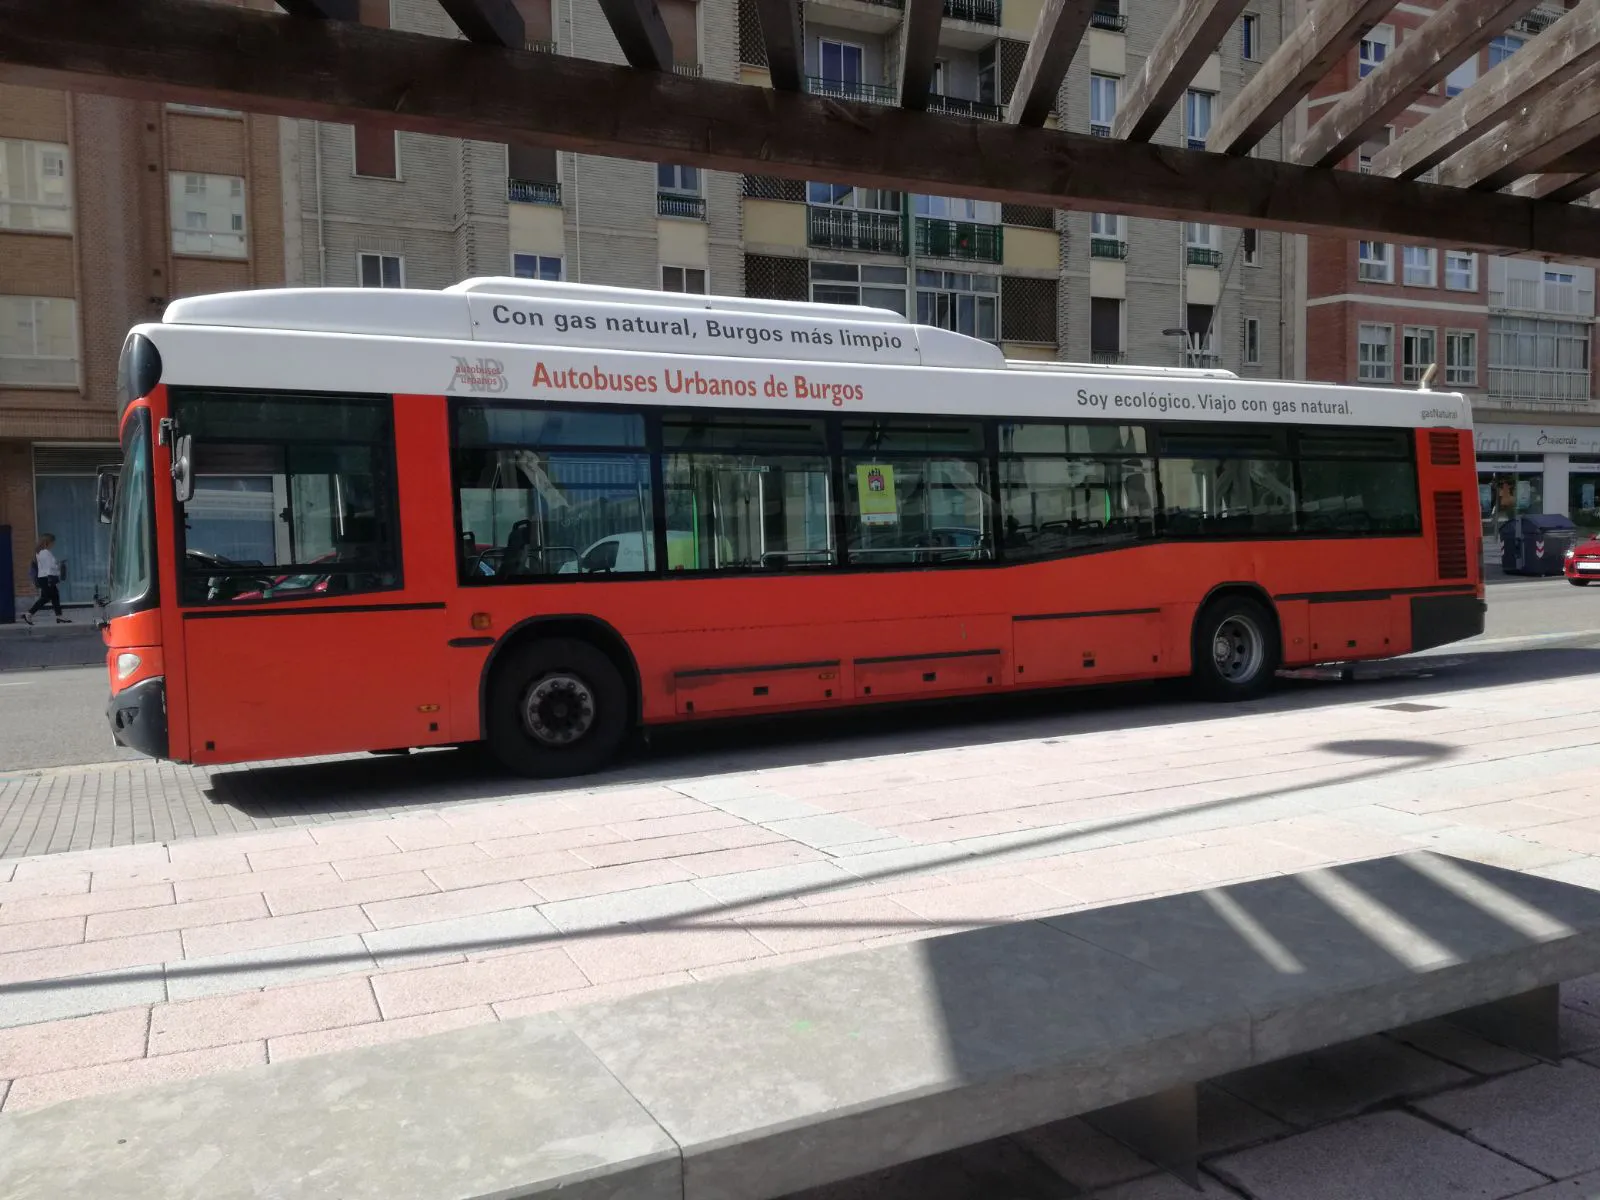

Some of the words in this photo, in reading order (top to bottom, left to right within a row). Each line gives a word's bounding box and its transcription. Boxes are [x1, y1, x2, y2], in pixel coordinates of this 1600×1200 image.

[492, 304, 545, 327] Con
[554, 314, 598, 333] gas
[606, 315, 698, 339] natural,
[706, 320, 784, 346] Burgos
[790, 328, 834, 346] más
[839, 329, 903, 352] limpio
[455, 364, 501, 375] autobuses
[461, 376, 498, 385] urbanos
[532, 361, 658, 394] Autobuses
[664, 369, 757, 399] Urbanos
[763, 374, 789, 398] de
[794, 375, 864, 406] Burgos
[1076, 389, 1107, 411] Soy
[1241, 399, 1268, 412] con
[1273, 399, 1297, 415] gas
[1301, 399, 1353, 416] natural.
